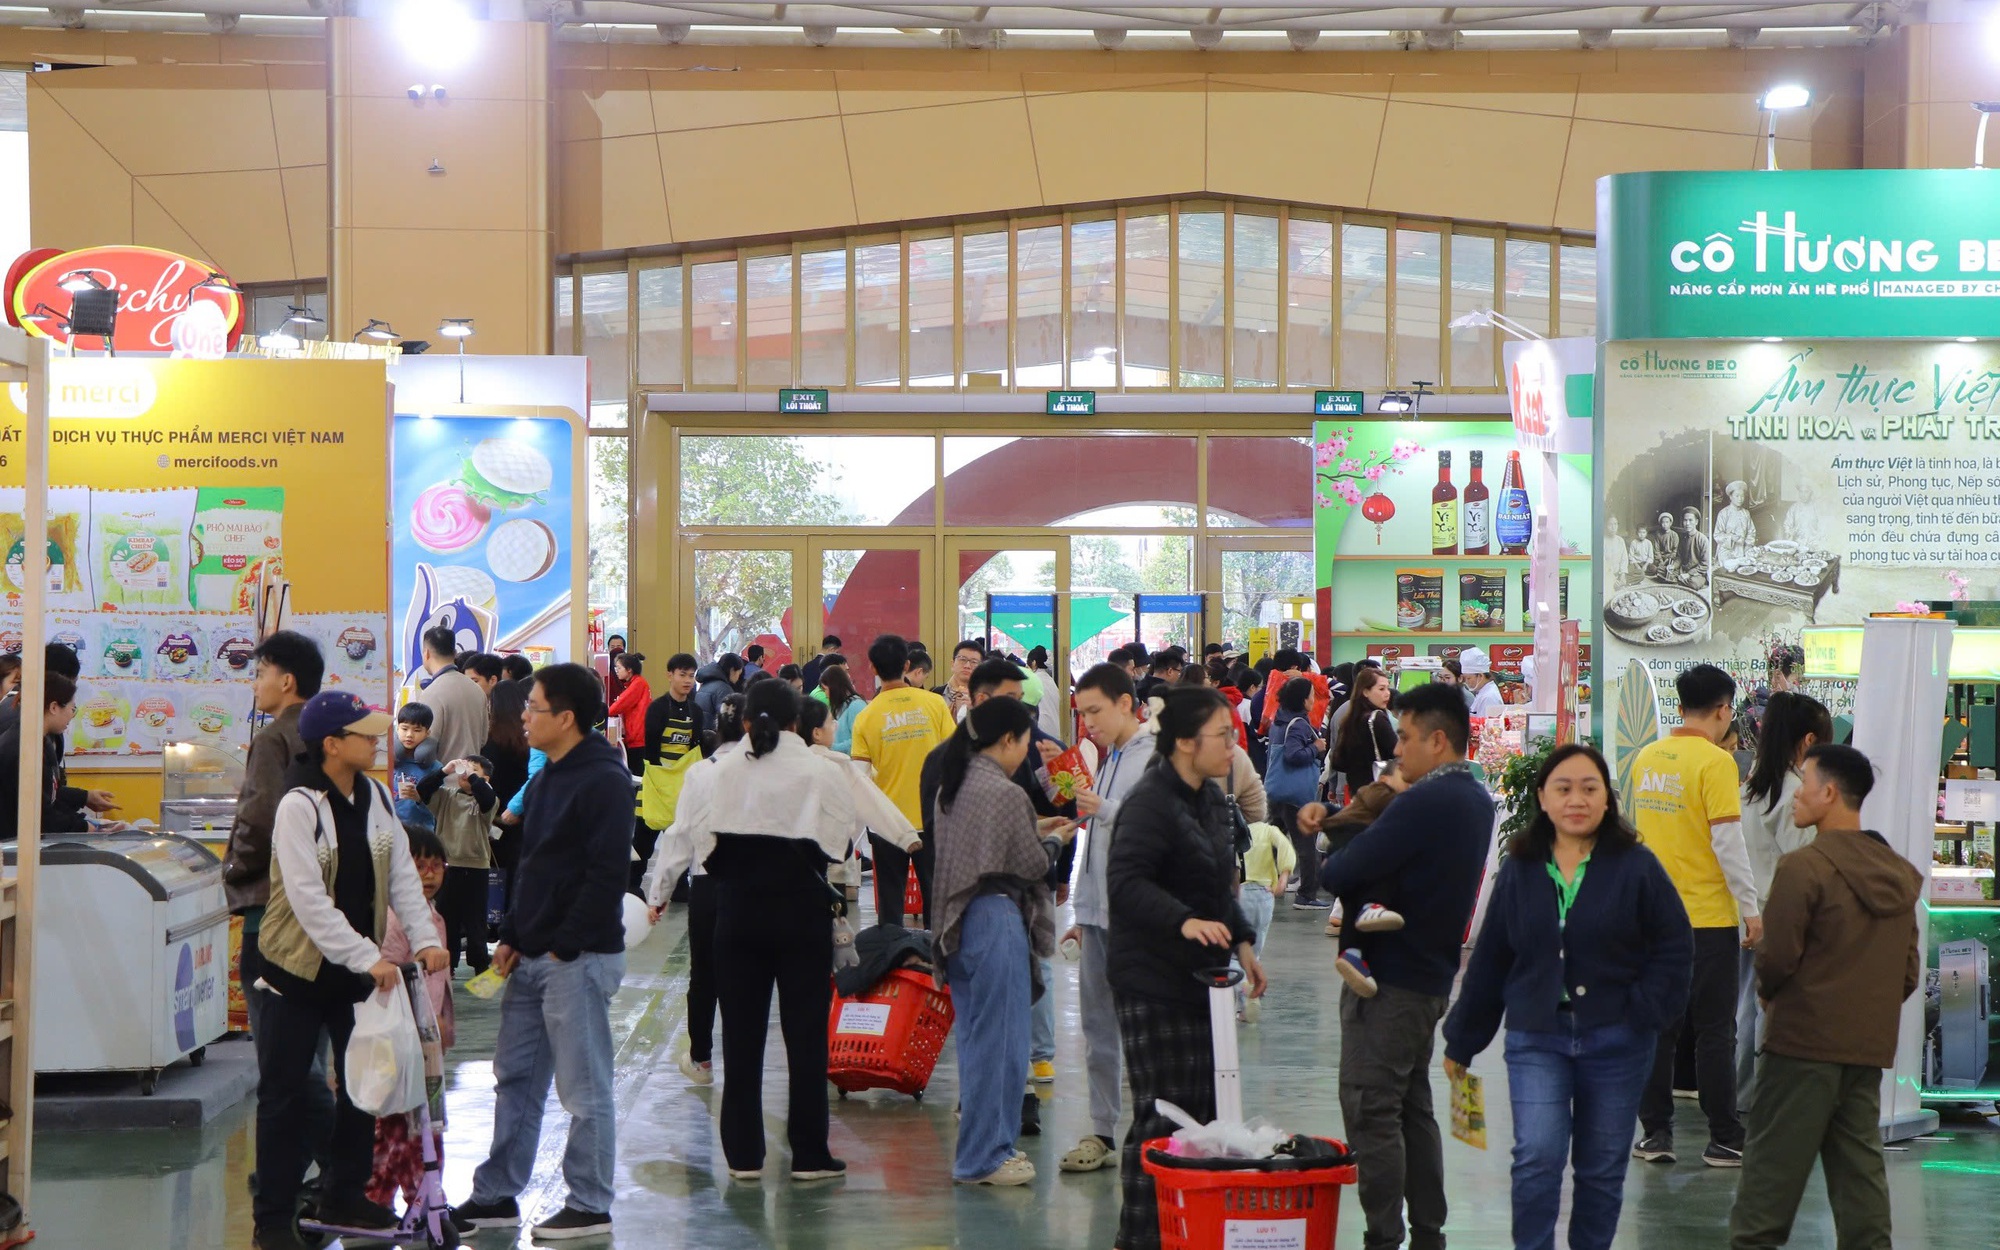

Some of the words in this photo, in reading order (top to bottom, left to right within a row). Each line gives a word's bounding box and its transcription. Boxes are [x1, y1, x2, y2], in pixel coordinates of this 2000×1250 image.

[1670, 233, 1735, 273] CÔ
[1738, 211, 1939, 273] HƯƠNG
[1670, 282, 1713, 295] NÂNG
[1788, 281, 1809, 295] ĂN
[1882, 284, 1955, 294] MANAGED
[1961, 284, 1978, 294] BY
[1746, 347, 1826, 415] Ẩm
[1834, 363, 1916, 413] thực
[62, 382, 140, 403] merci
[799, 401, 822, 410] THOÁT
[1066, 402, 1089, 411] THOÁT
[1334, 402, 1357, 411] THOÁT
[1727, 415, 1788, 440] TINH
[1798, 415, 1854, 440] HOA
[1881, 411, 1955, 440] PHÁT
[0, 424, 22, 443] ẤT
[53, 430, 91, 445] DỊCH
[96, 430, 117, 445] VỤ
[121, 428, 164, 445] THỰC
[169, 424, 213, 444] PHẨM
[218, 431, 267, 444] MERCI
[272, 428, 306, 446] VIỆT
[311, 431, 345, 444] NAM
[174, 455, 278, 469] mercifoods.vn
[1855, 457, 1885, 472] thực
[1887, 457, 1913, 472] Việt
[1915, 457, 1926, 470] là
[1928, 457, 1951, 470] tinh
[1954, 457, 1980, 471] hoa,
[1982, 457, 1993, 470] là
[1837, 475, 1863, 490] Lịch
[1888, 475, 1928, 490] Phong
[1931, 476, 1954, 490] tục,
[1957, 474, 1983, 490] Nếp
[1842, 492, 1865, 506] của
[1867, 493, 1902, 508] người
[1904, 493, 1929, 508] Việt
[1931, 495, 1954, 508] qua
[1956, 493, 1990, 506] nhiều
[1846, 514, 1876, 527] sang
[1878, 513, 1914, 527] trọng,
[1916, 512, 1939, 525] tinh
[1956, 512, 1980, 525] đến
[226, 523, 243, 532] MAI
[1849, 530, 1876, 543] món
[1881, 530, 1905, 543] đều
[1909, 530, 1941, 543] chứa
[1946, 530, 1979, 545] đựng
[1849, 549, 1889, 563] phong
[1891, 549, 1911, 563] tục
[1913, 549, 1926, 561] và
[1929, 550, 1946, 563] sự
[1948, 549, 1963, 561] tài
[1965, 549, 1988, 561] hoa
[1649, 659, 1672, 671] đơn
[1661, 713, 1684, 725] bữa
[1636, 766, 1667, 793] ĂN
